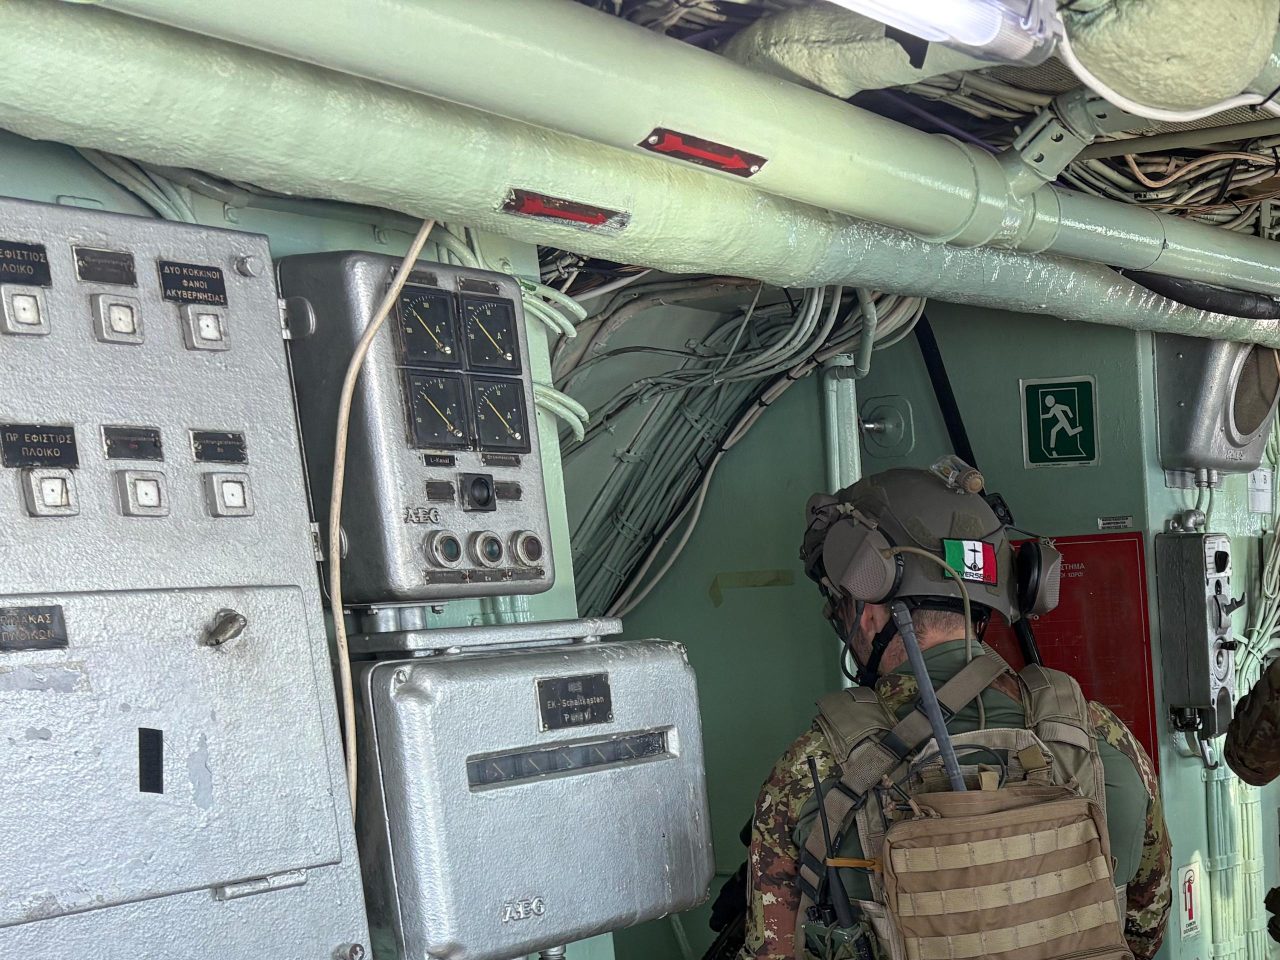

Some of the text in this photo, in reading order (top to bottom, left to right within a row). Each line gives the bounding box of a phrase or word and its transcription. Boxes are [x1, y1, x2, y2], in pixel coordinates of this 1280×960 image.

[164, 265, 220, 280] ΔΥΟ ΚΟΚΚΙΝΟΙ
[181, 279, 208, 289] ΦΑΝΟΙ
[24, 433, 73, 444] ΕΦΙΣΤΙΟΣ
[21, 447, 61, 457] ΠΛΟΙΚΟ
